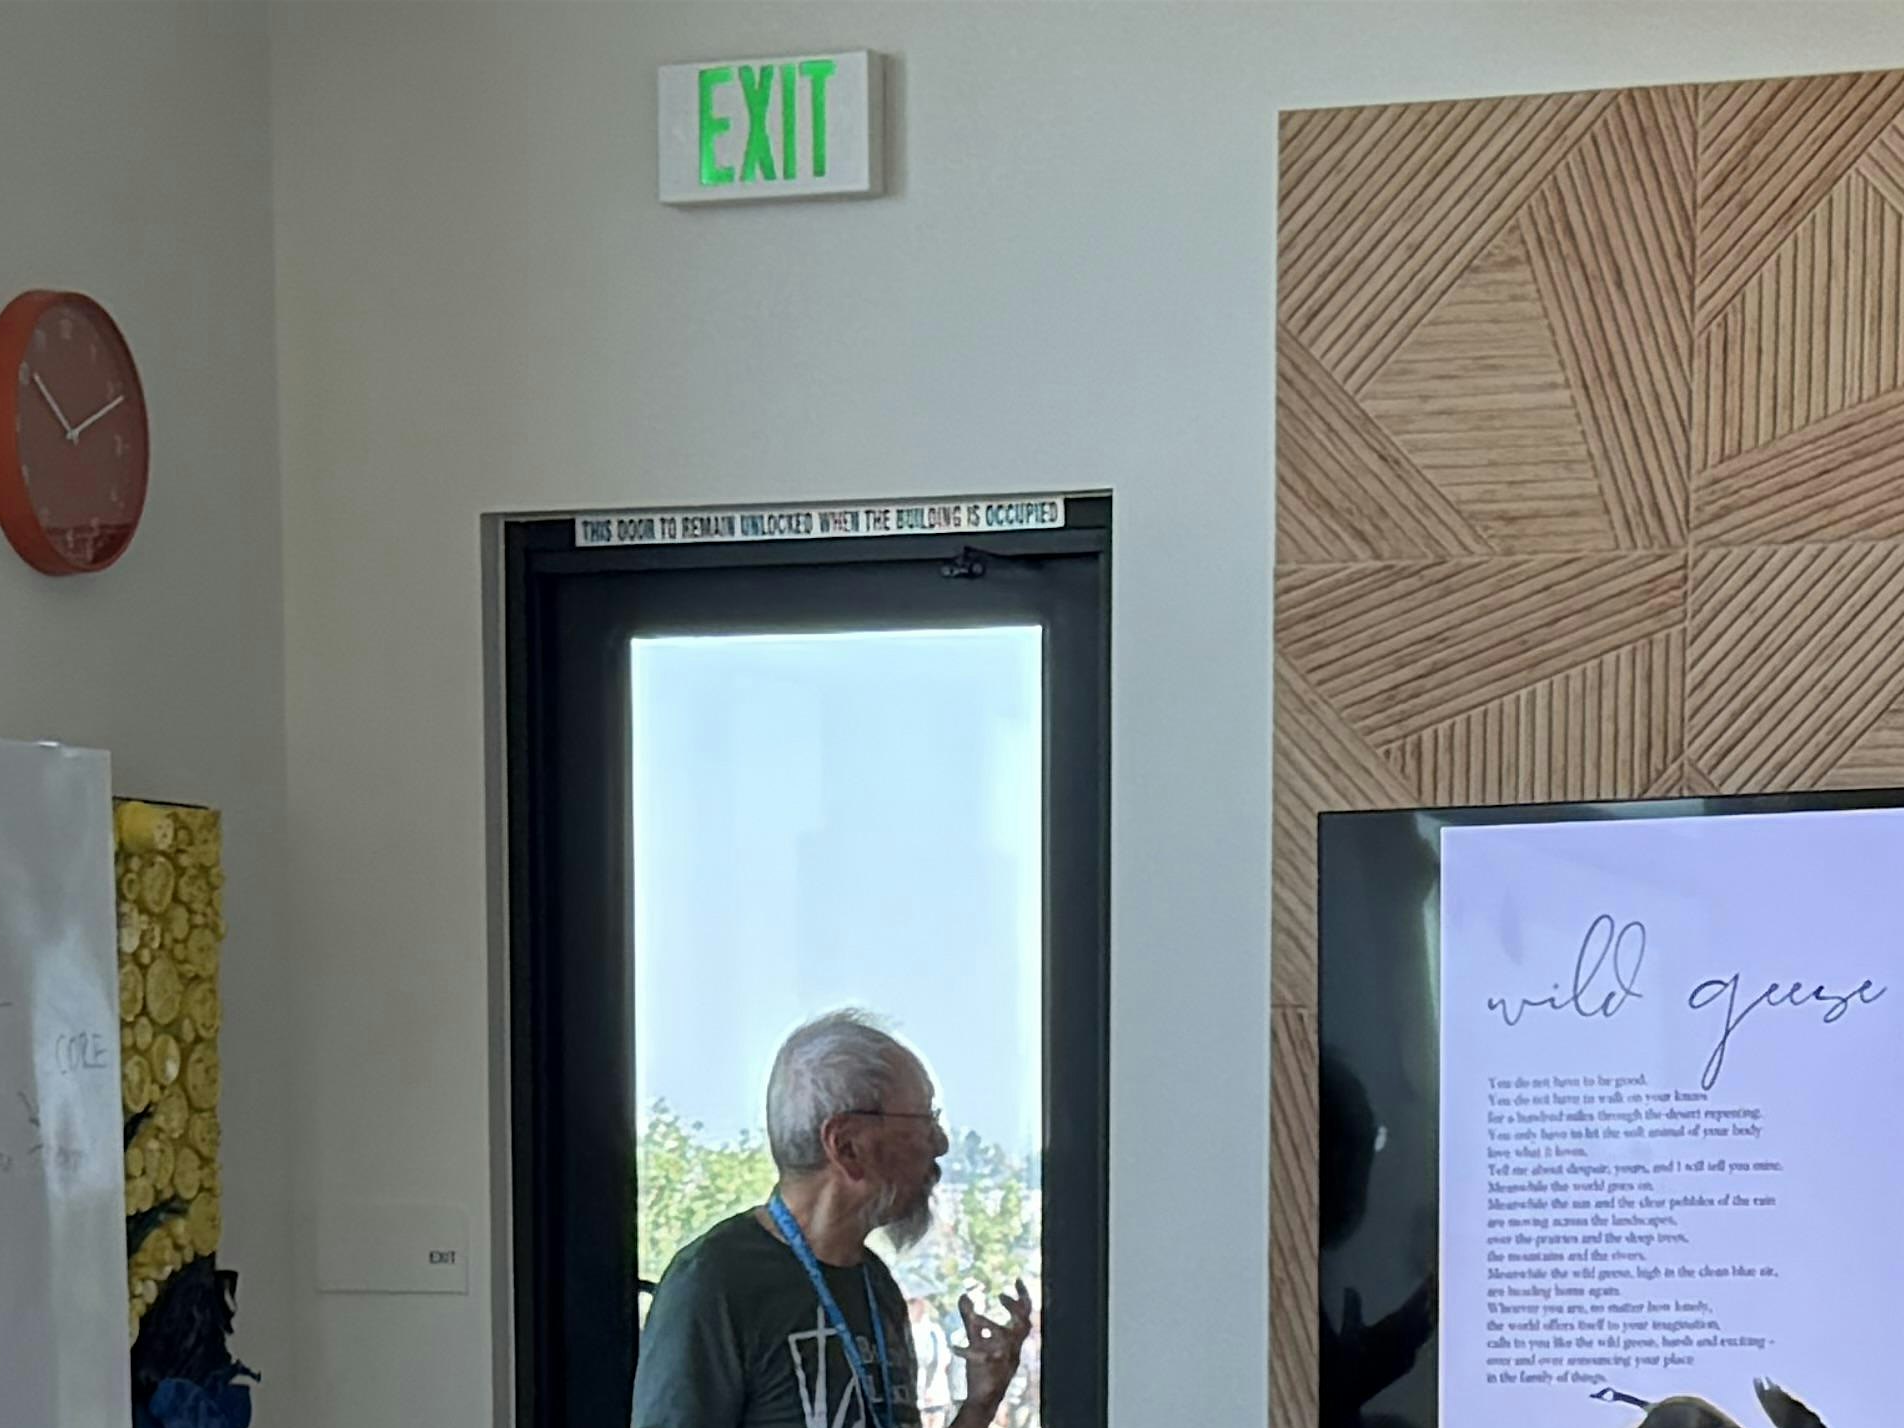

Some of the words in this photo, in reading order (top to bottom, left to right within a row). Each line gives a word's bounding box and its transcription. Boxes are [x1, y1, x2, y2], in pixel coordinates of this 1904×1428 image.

[699, 59, 837, 186] EXIT
[583, 520, 612, 542] THIS
[617, 519, 655, 540] DOOR
[660, 518, 676, 539] TO
[682, 516, 735, 538] REMAIN
[741, 513, 812, 536] UNLOCKED
[819, 511, 859, 532] WHEN
[865, 510, 890, 531] THE
[896, 506, 961, 529] BUILDING
[967, 505, 980, 527] IS
[986, 502, 1058, 526] OCCUPIED
[1487, 914, 1646, 1026] wild
[1688, 973, 1887, 1090] geese
